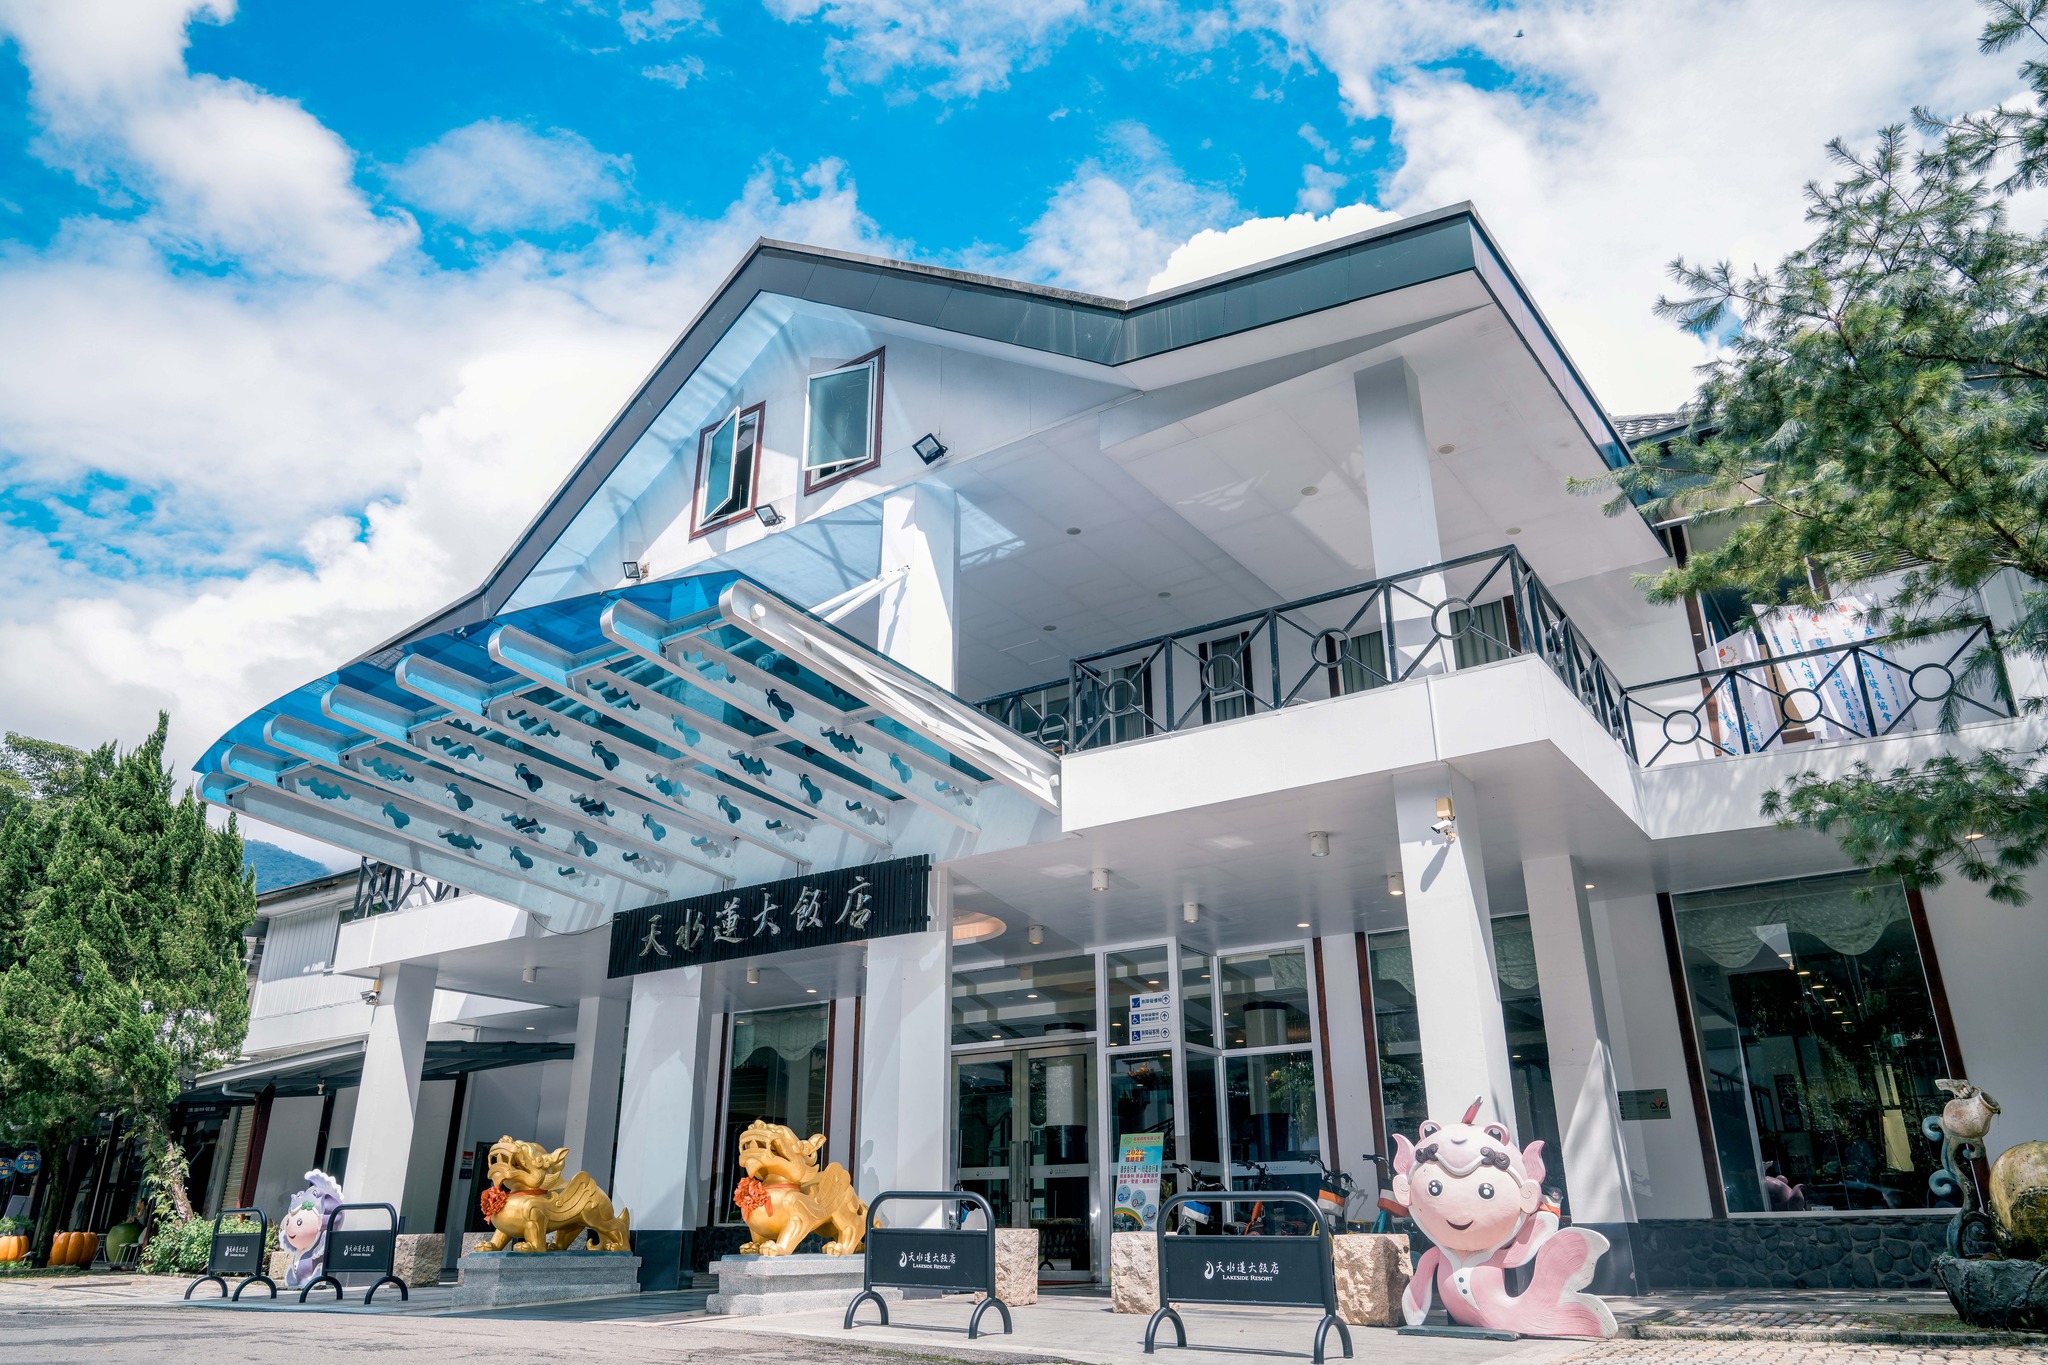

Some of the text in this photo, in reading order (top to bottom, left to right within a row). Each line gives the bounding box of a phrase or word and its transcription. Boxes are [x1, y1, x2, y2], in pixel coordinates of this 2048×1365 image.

[639, 876, 873, 957] 天水蓮大飯店
[908, 1251, 956, 1264] 天水蓮大飯店
[1216, 1261, 1279, 1274] 天水蓮大飯店
